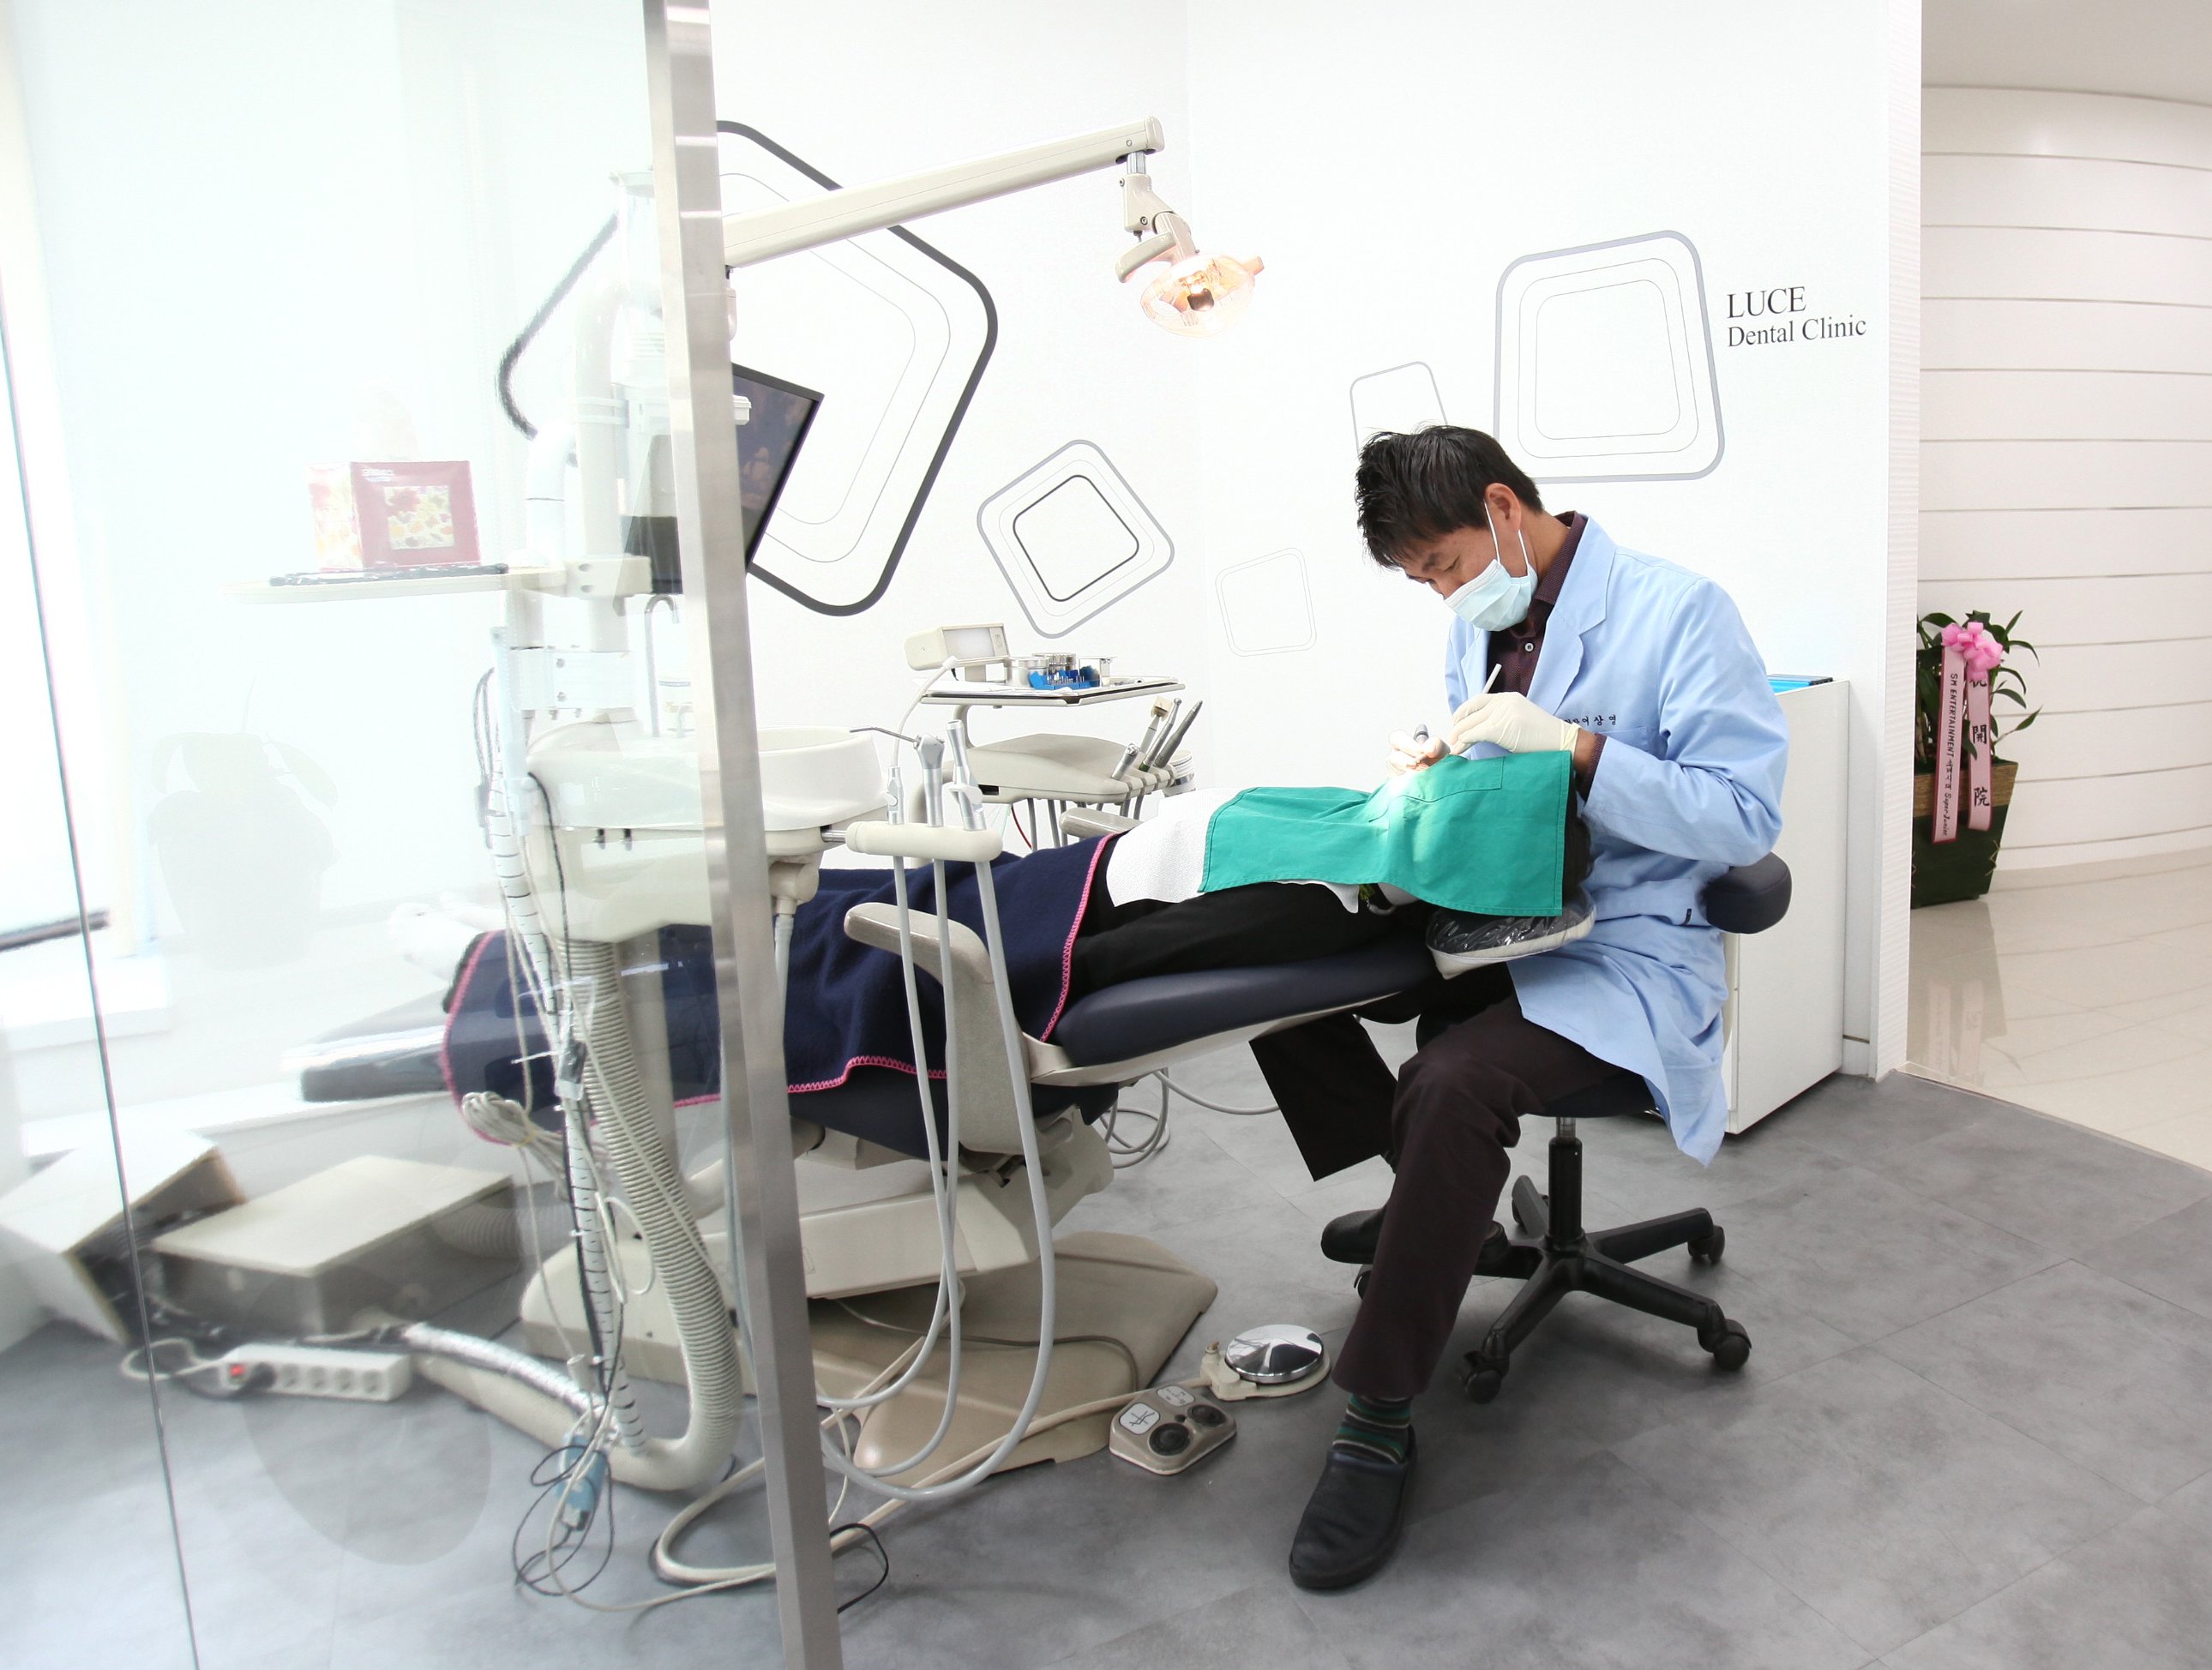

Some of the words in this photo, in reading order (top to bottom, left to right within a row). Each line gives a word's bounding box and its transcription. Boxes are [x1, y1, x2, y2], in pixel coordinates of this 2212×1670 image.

[1726, 285, 1807, 319] LUCE
[1728, 320, 1794, 347] Dental
[1801, 314, 1867, 340] Clinic
[1950, 673, 1958, 687] SM
[1946, 688, 1957, 757] ENTERTAINMENT
